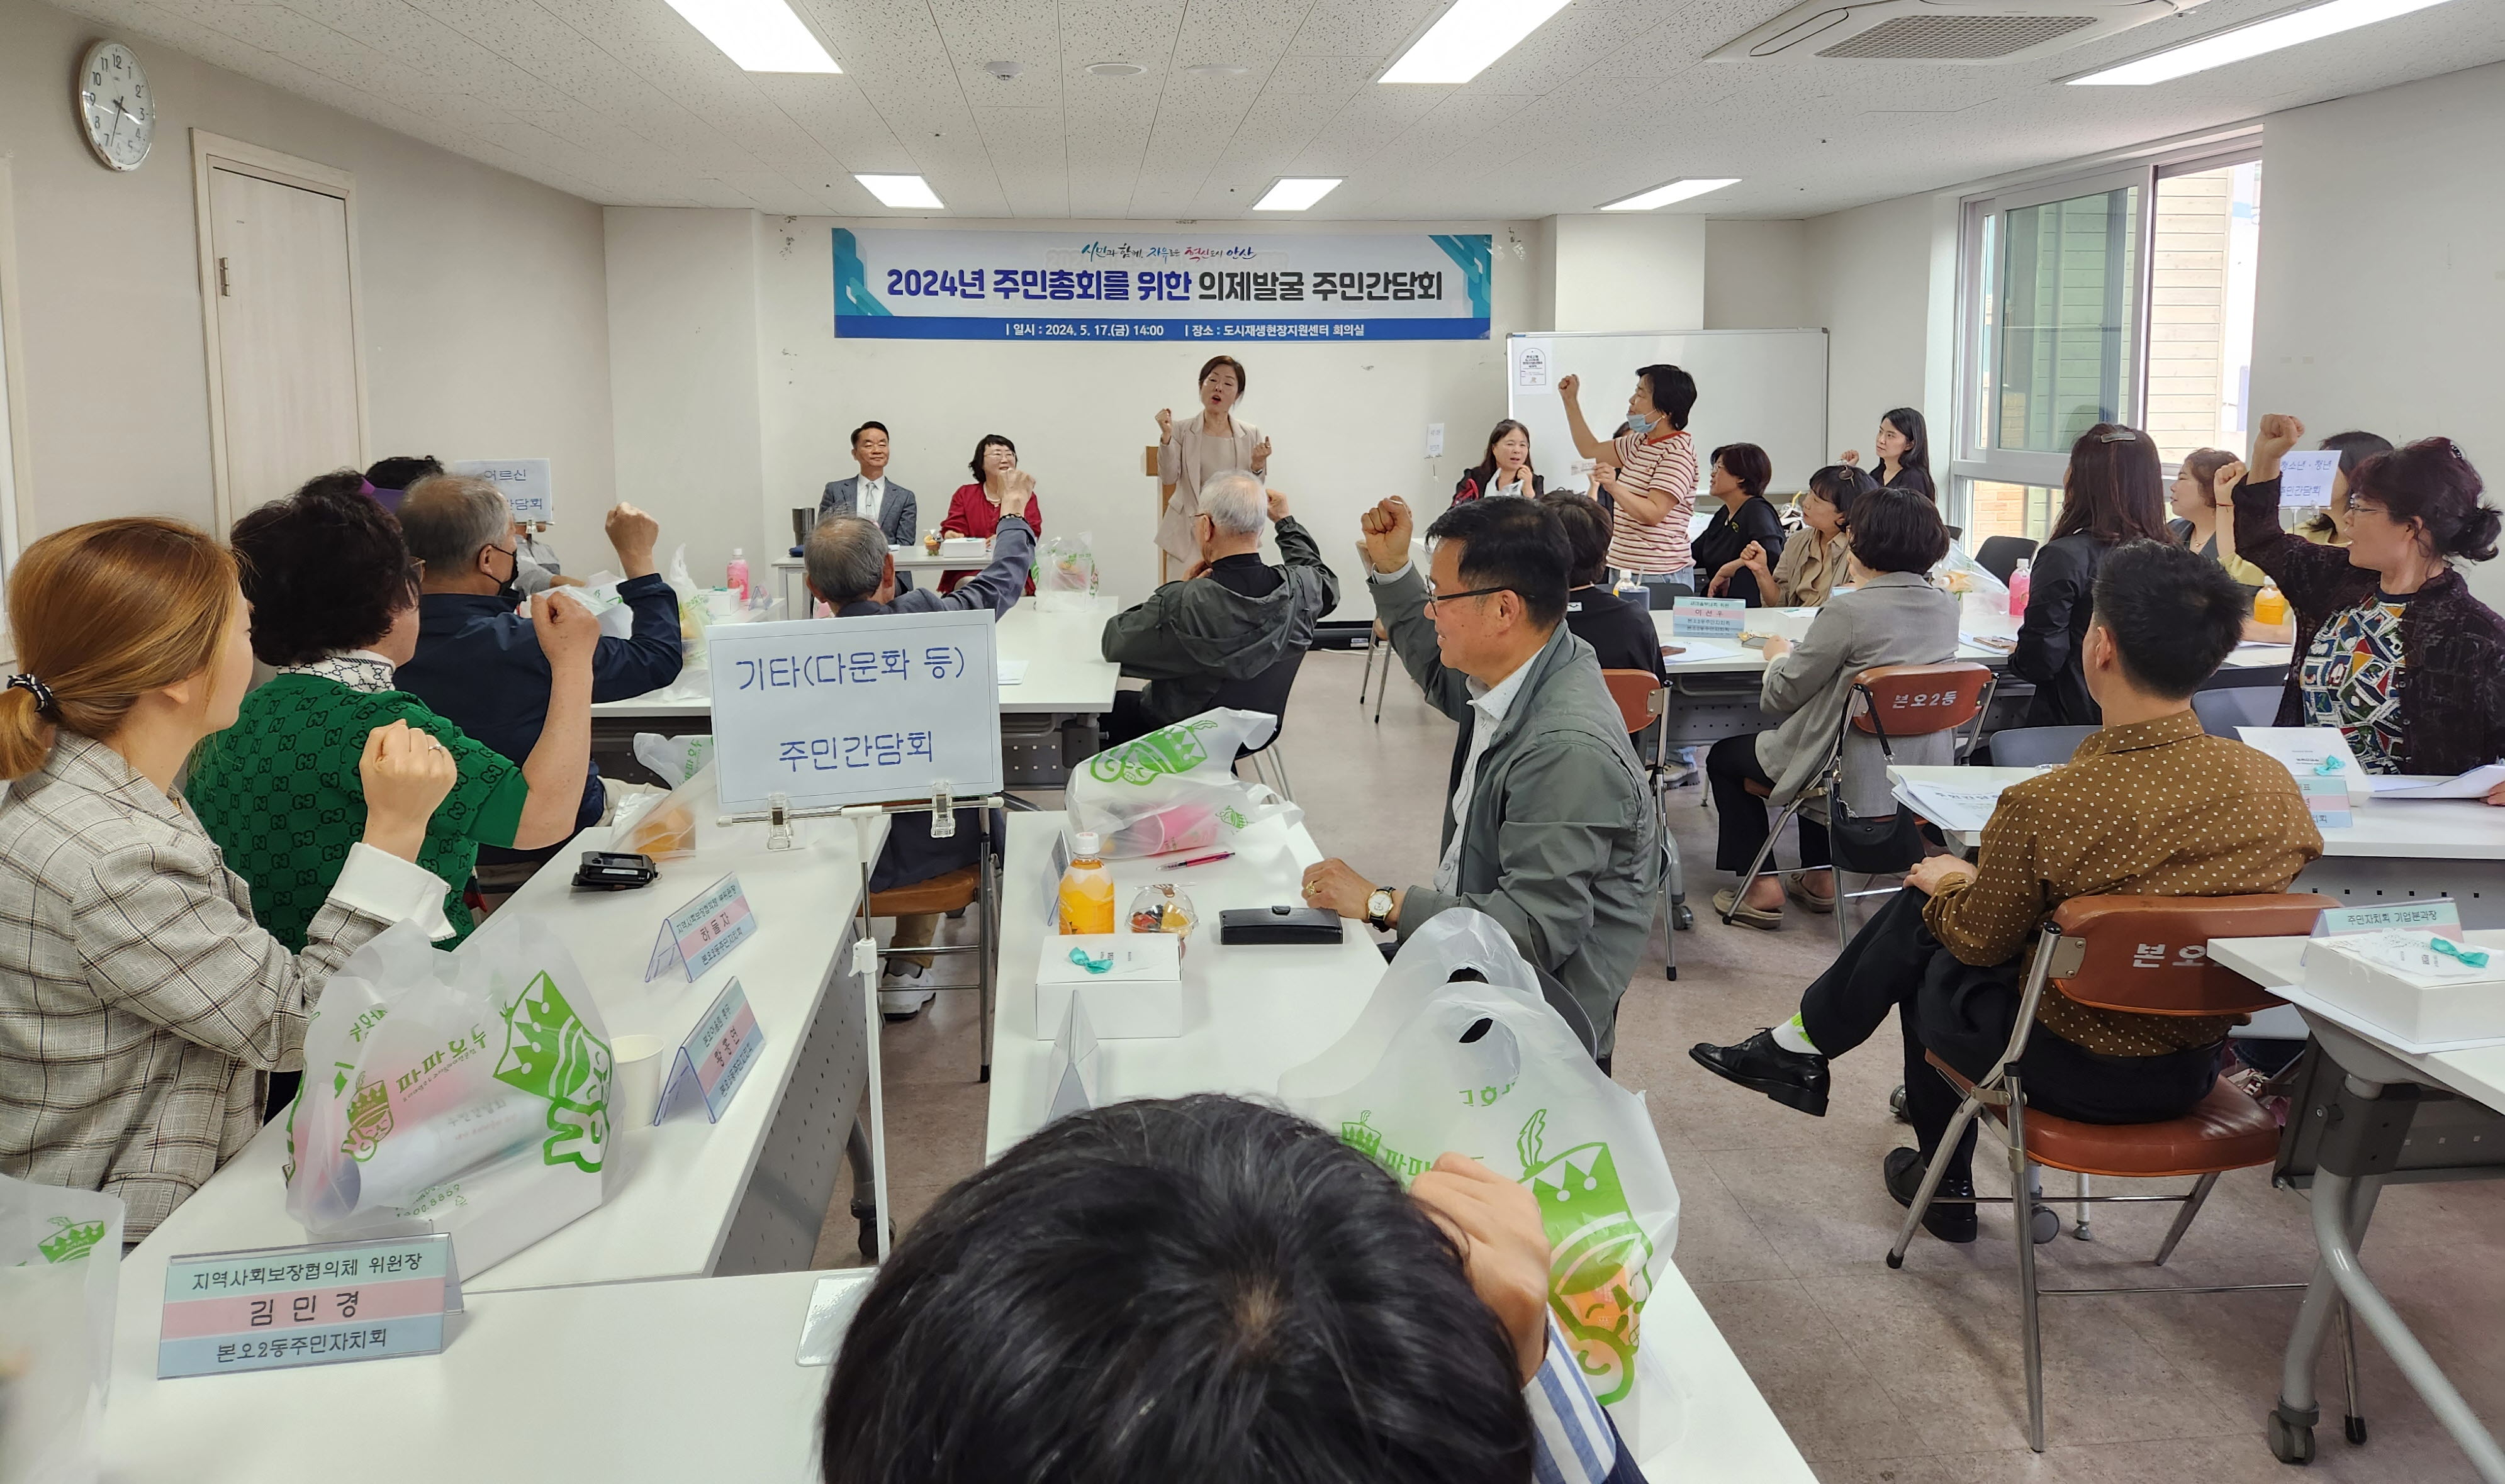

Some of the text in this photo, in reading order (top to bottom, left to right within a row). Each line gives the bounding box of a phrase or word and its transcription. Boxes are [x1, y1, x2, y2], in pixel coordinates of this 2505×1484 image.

[101, 57, 108, 71] 11
[112, 54, 121, 69] 12
[92, 72, 101, 86] 10
[128, 66, 131, 79] 1
[135, 85, 141, 98] 2
[89, 92, 96, 106] 9
[140, 108, 144, 120] 3
[95, 116, 100, 128] 8
[104, 133, 109, 146] 7
[128, 140, 133, 150] 5
[1226, 246, 1257, 260] 안산
[887, 269, 1442, 301] 2024년 주민총회를 위한 의제발굴 주민간담회
[1014, 324, 1035, 335] 일시
[1045, 324, 1077, 336] 2024.
[1080, 325, 1090, 336] 5.
[1095, 325, 1129, 337] 17.(금)
[1134, 325, 1164, 336] 14:00
[1192, 325, 1214, 337] 장소
[1223, 325, 1329, 337] 도시재생현장지원센터
[1333, 325, 1365, 337] 회의실
[2281, 460, 2306, 471] 청소년
[483, 469, 527, 481] 어르신
[736, 647, 965, 690] 기타(다문화 등)
[1892, 691, 1958, 709] 본오2동
[779, 730, 933, 773] 주민간담회
[676, 900, 719, 934] 지역사회보장협의체
[2348, 910, 2437, 925] 주민자치회 기업분과장
[700, 927, 710, 941] 하
[720, 912, 730, 927] 자
[2132, 943, 2224, 968] 본오
[192, 1252, 422, 1291] 지역사회보장협의체 위원장
[250, 1290, 360, 1327] 김 민 경
[216, 1327, 387, 1363] 본오2동주민자치회
